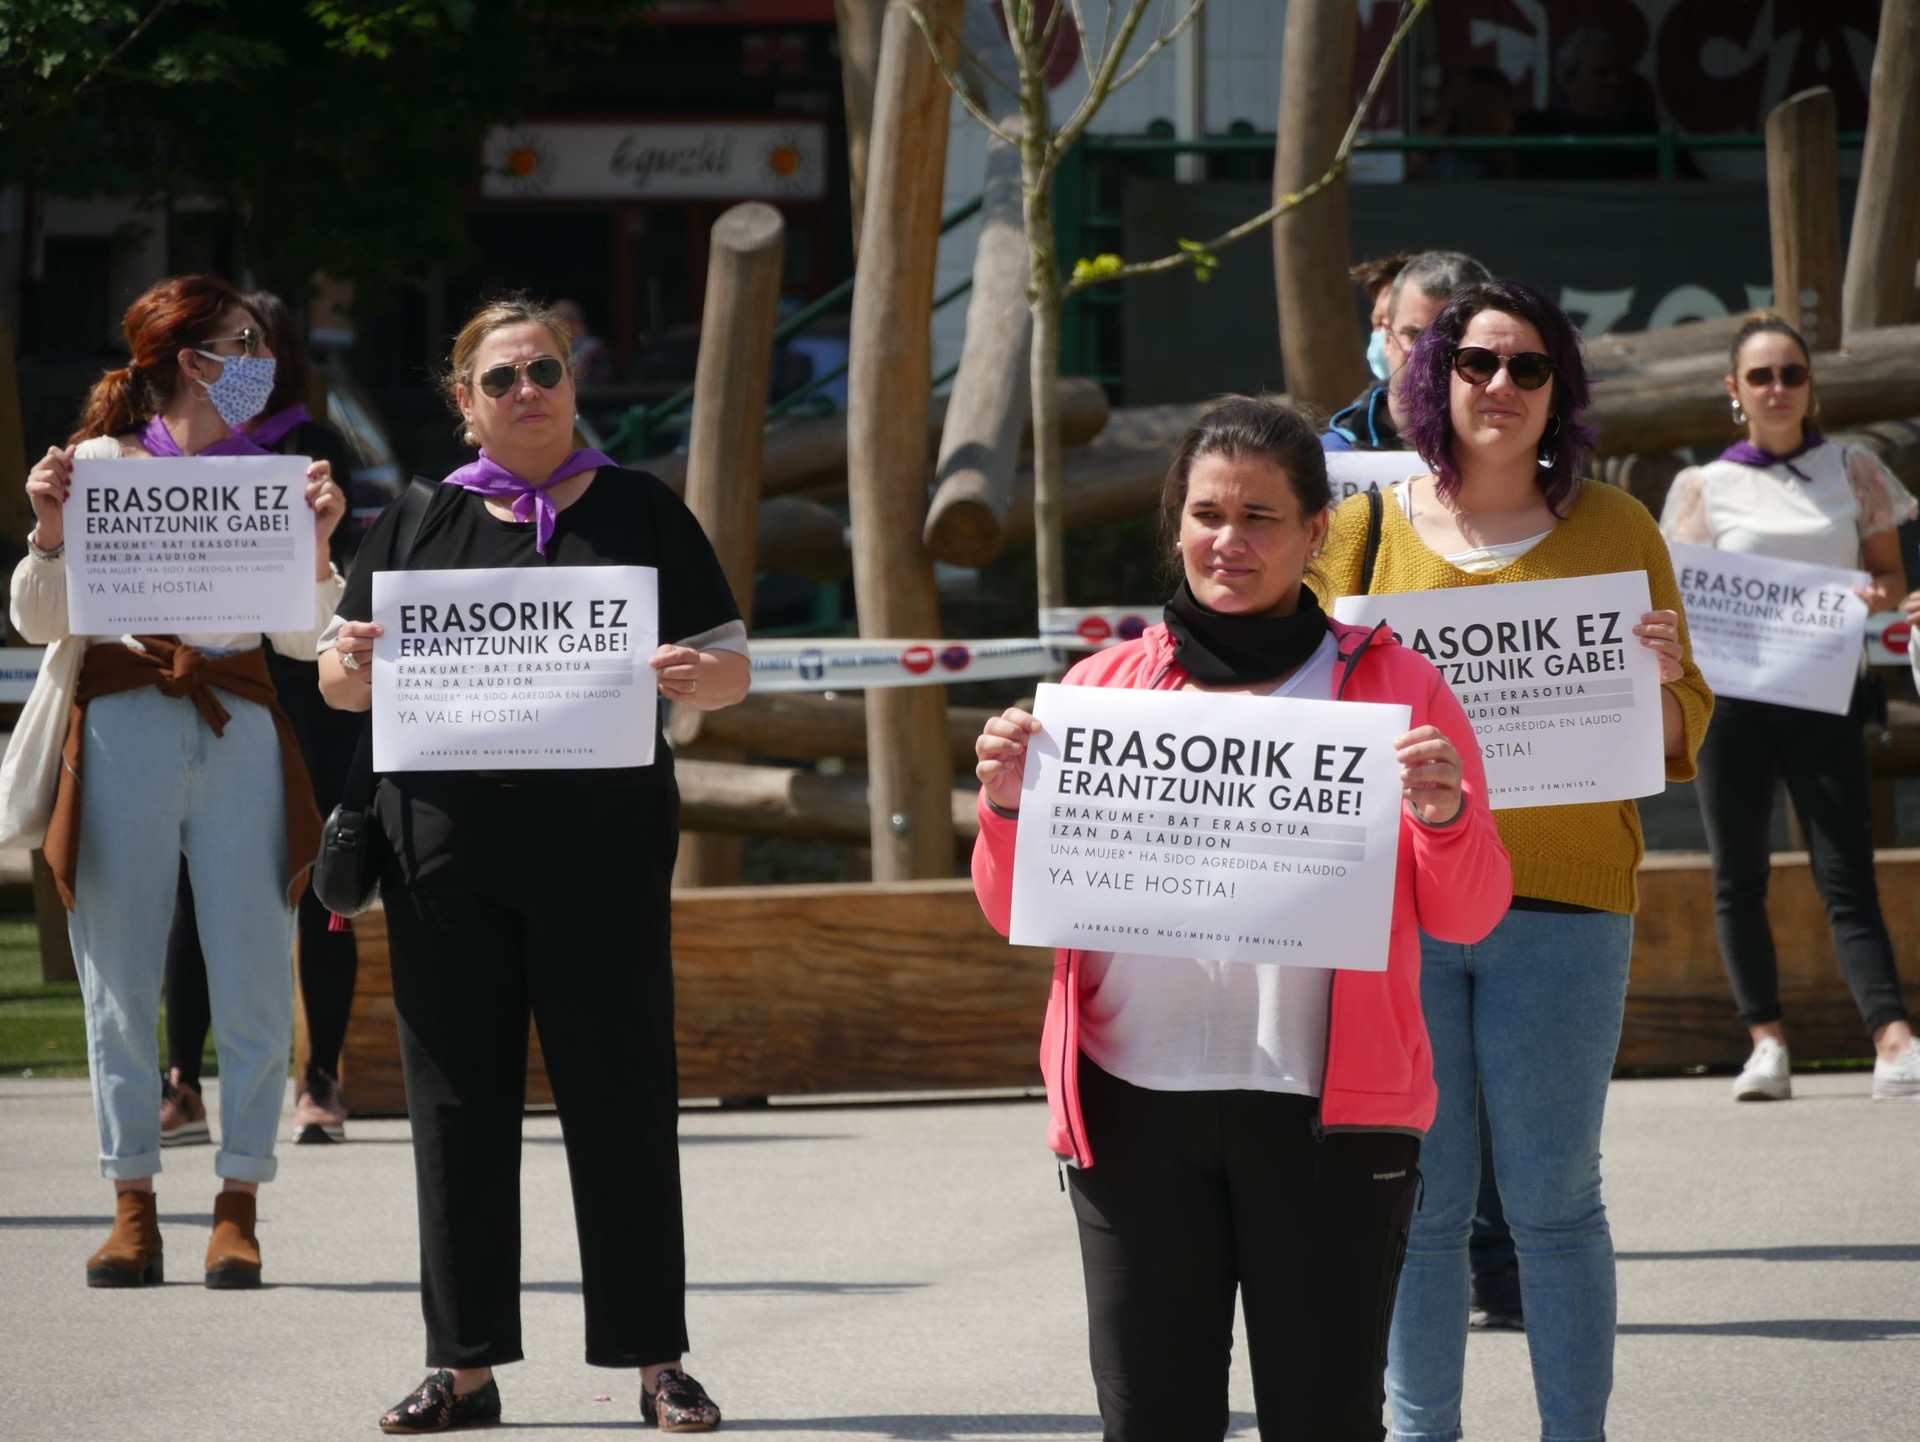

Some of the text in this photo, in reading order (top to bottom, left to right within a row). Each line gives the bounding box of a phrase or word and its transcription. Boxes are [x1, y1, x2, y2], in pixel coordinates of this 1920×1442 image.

[87, 486, 288, 512] ERASORIK EZ
[87, 515, 289, 534] ERANTZUNIK GABE!
[87, 554, 117, 562] IZAN
[150, 553, 207, 561] LAUDION
[147, 566, 159, 574] HA
[188, 565, 233, 573] AGREDIDA
[251, 564, 284, 572] LAUDIO
[88, 581, 213, 594] YA VALE HOSTIA!
[1680, 568, 1845, 612] ERASORIK EZ
[400, 600, 628, 633] ERASORIK EZ
[1792, 610, 1844, 629] GABE!
[401, 633, 628, 657] ERANTZUNIK GABE!
[1392, 612, 1623, 661] ASORIK EZ
[485, 664, 508, 673] BAT
[518, 663, 591, 672] ERASOTUA
[1440, 651, 1625, 685] TZUNIK GABE!
[398, 677, 533, 687] IZAN DA LAUDION
[398, 693, 420, 702] UNA
[465, 692, 480, 701] HA
[483, 692, 507, 700] SIDO
[511, 691, 562, 700] AGREDIDA
[583, 689, 620, 698] LAUDIO
[1463, 685, 1585, 704] BAT ERASOTUA
[398, 709, 539, 724] YA VALE HOSTIA!
[1468, 705, 1520, 719] UDION
[1498, 719, 1555, 733] AGREDIDA
[1560, 718, 1575, 728] EN
[1580, 714, 1622, 727] LAUDIO
[1063, 727, 1368, 784] ERASORIK EZ
[1058, 770, 1362, 816] ERANTZUNIK GABE!
[1541, 780, 1596, 791] FEMINISTA
[1168, 815, 1200, 827] BAT
[1213, 818, 1310, 837] ERASOTUA
[1053, 825, 1231, 849] IZAN DA LAUDION
[1050, 844, 1078, 856] UNA
[1139, 851, 1158, 862] HA
[1163, 852, 1196, 865] SIDO
[1201, 856, 1268, 871] AGREDIDA
[1274, 861, 1291, 872] EN
[1297, 863, 1346, 877] LAUDIO
[1048, 867, 1236, 899] YA VALE HOSTIA!
[1073, 923, 1303, 947] AIARALDEKO MUGIMENDU FEMINISTA
